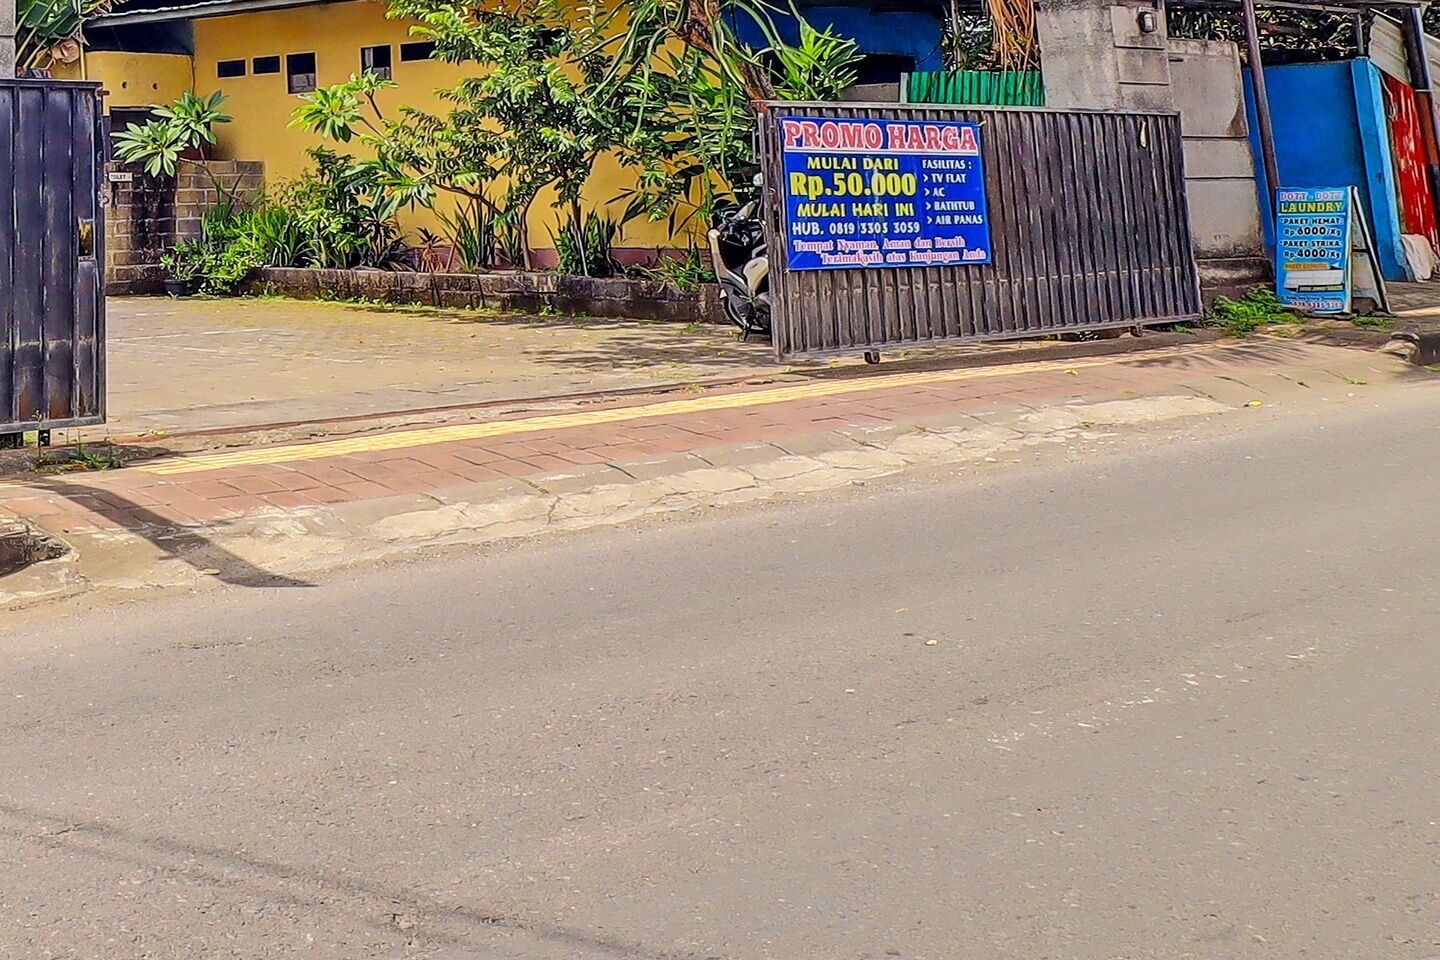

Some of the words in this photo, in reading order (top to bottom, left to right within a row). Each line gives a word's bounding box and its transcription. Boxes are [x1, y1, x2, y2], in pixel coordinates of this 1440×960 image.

[783, 121, 883, 149] PROMO
[887, 124, 978, 153] HARGA
[807, 157, 857, 170] MULAI
[863, 157, 899, 170] DARI
[922, 160, 966, 169] FASILITAS
[931, 174, 943, 183] TV
[946, 174, 966, 183] FLAT
[790, 172, 916, 200] Rp.50.000
[933, 188, 946, 197] AC
[797, 203, 846, 217] MULAI
[853, 203, 888, 216] HARI
[895, 203, 914, 216] INI
[934, 201, 975, 211] BATHTUB
[1281, 202, 1342, 213] LAUNDRY
[935, 215, 952, 225] AIR
[954, 215, 983, 224] PANAS
[792, 222, 824, 235] HUB.
[829, 222, 855, 234] 0819
[860, 222, 888, 234] 3303
[893, 222, 920, 233] 3059
[793, 240, 834, 254] Tempat
[882, 238, 912, 249] Aman
[913, 237, 933, 248] dan
[934, 236, 965, 248] Bersih
[886, 253, 906, 263] atas
[909, 250, 960, 264] Kunjungan
[962, 248, 986, 260] Anda
